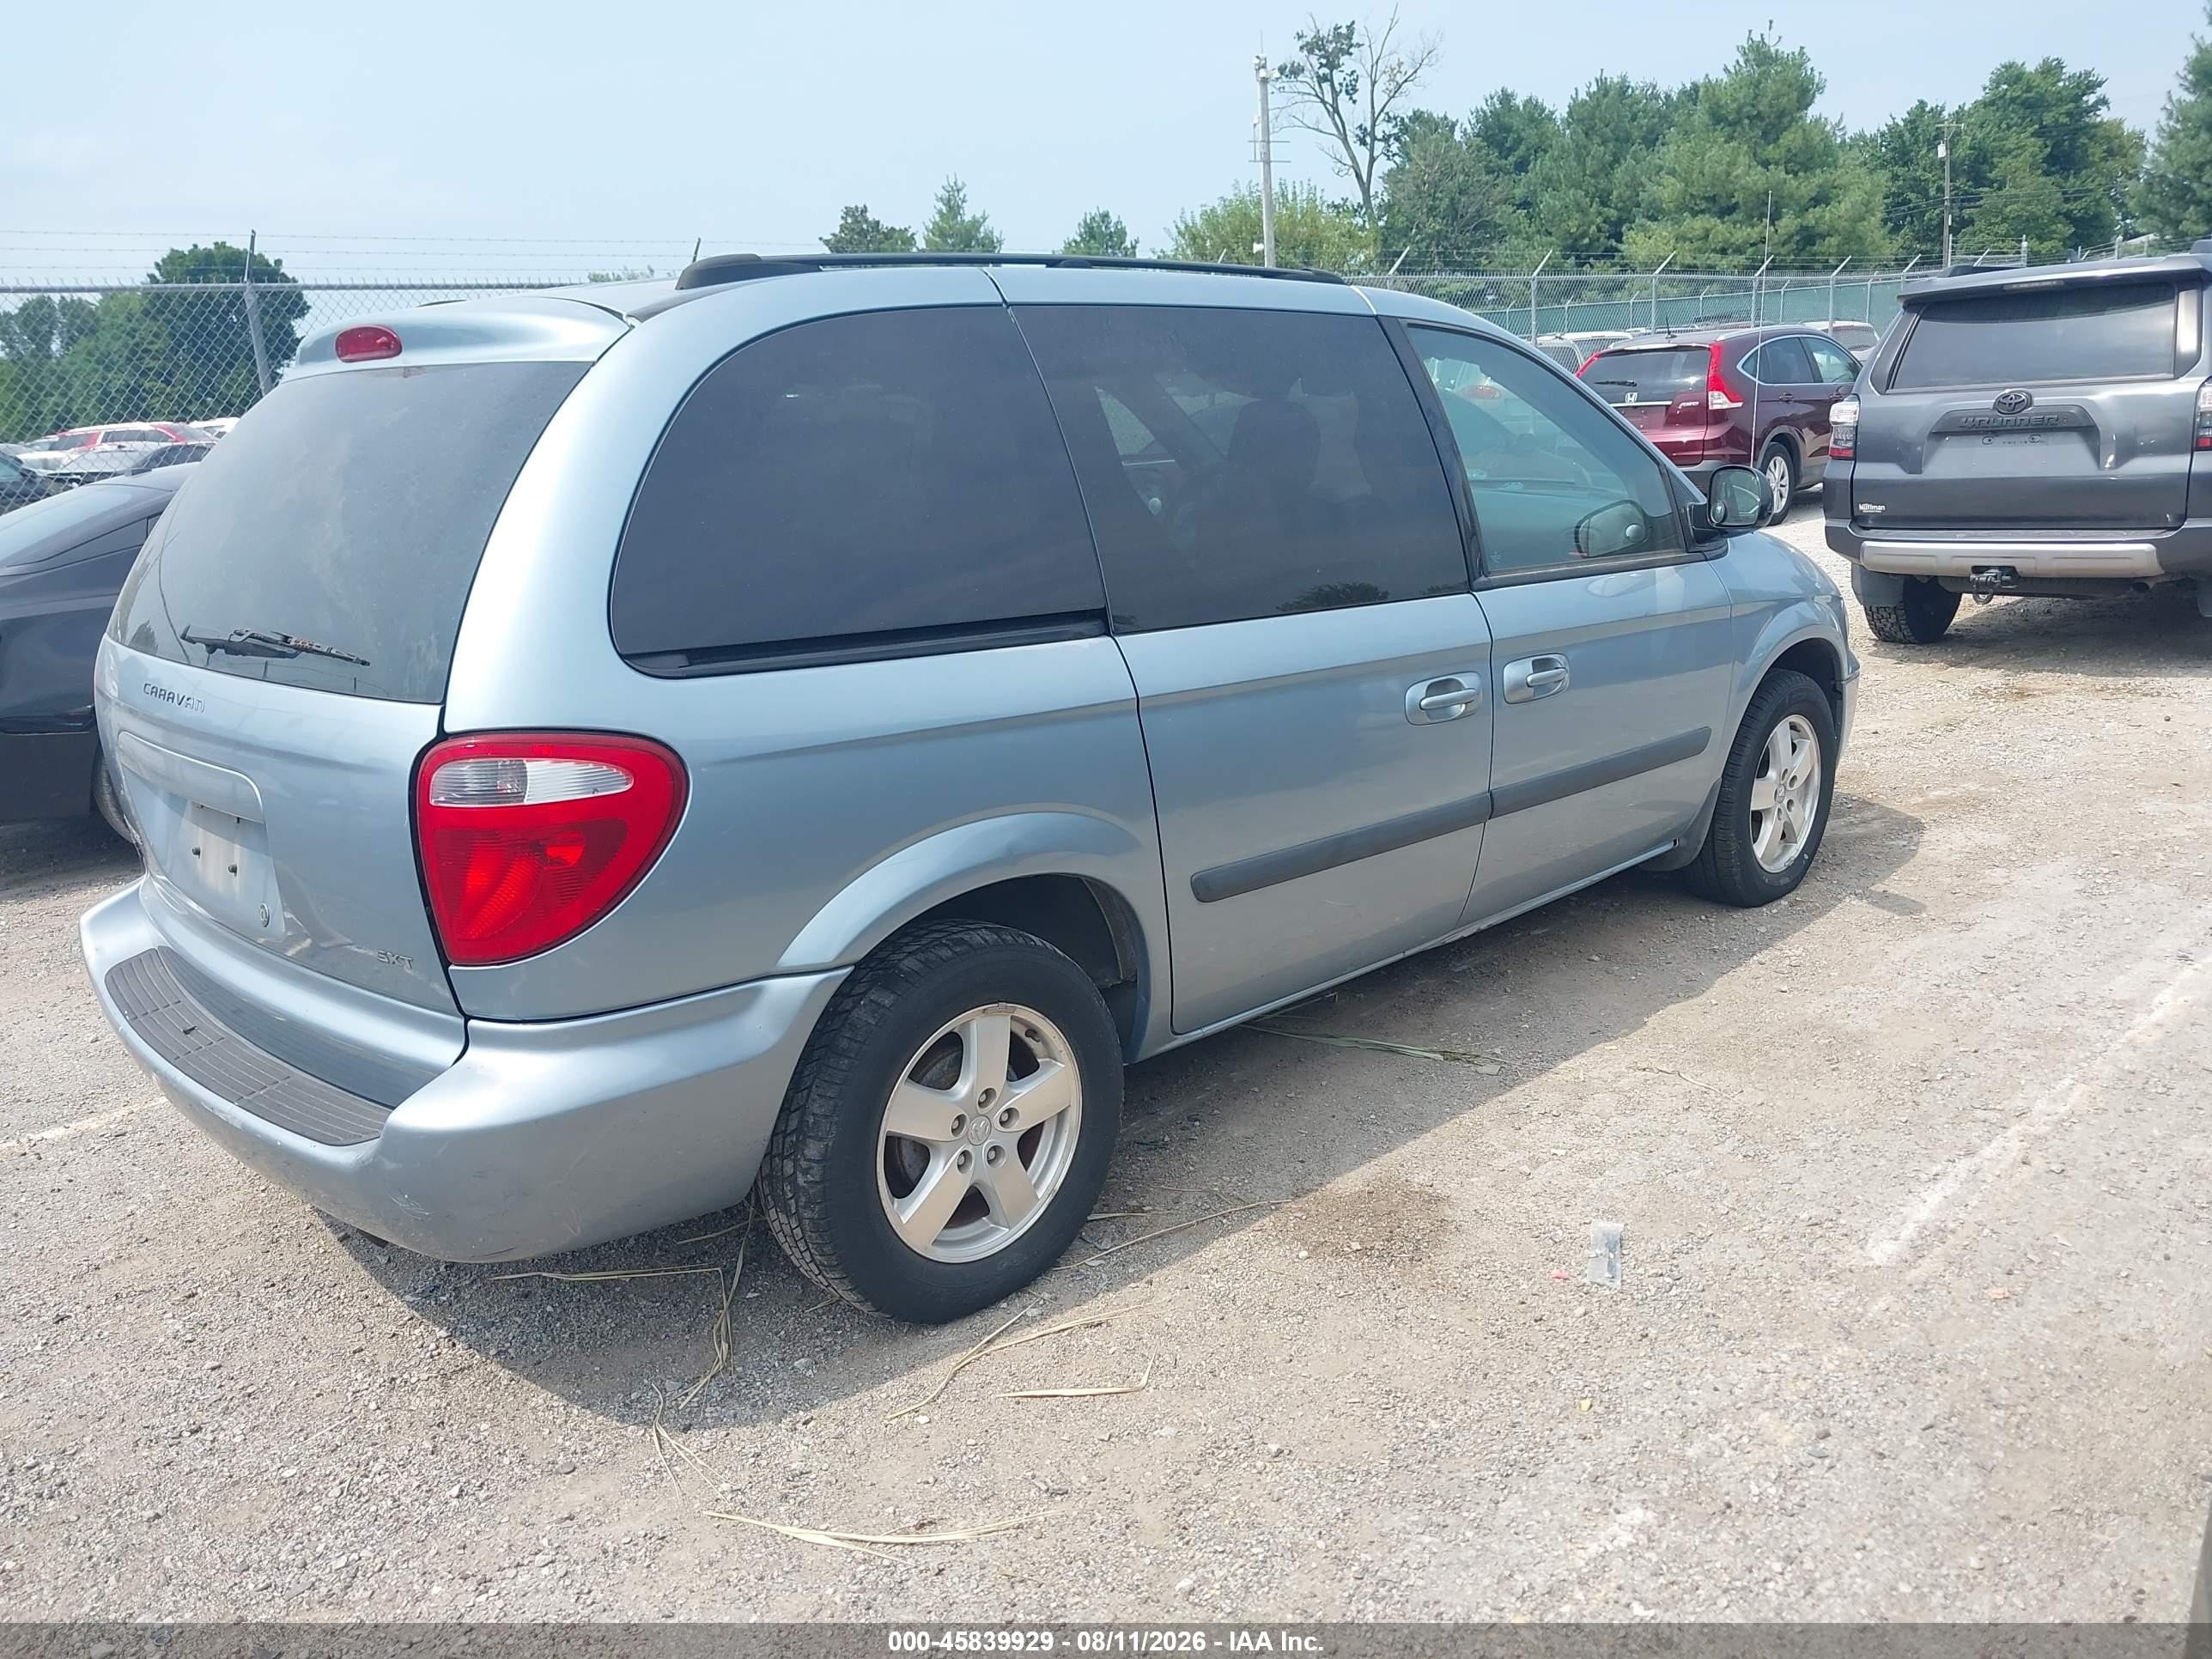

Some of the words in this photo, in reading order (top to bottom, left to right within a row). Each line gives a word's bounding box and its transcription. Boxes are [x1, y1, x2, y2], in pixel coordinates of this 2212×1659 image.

[1959, 415, 2059, 428] 4RUNNER
[143, 683, 205, 714] CARAVAN
[377, 950, 414, 969] SXT
